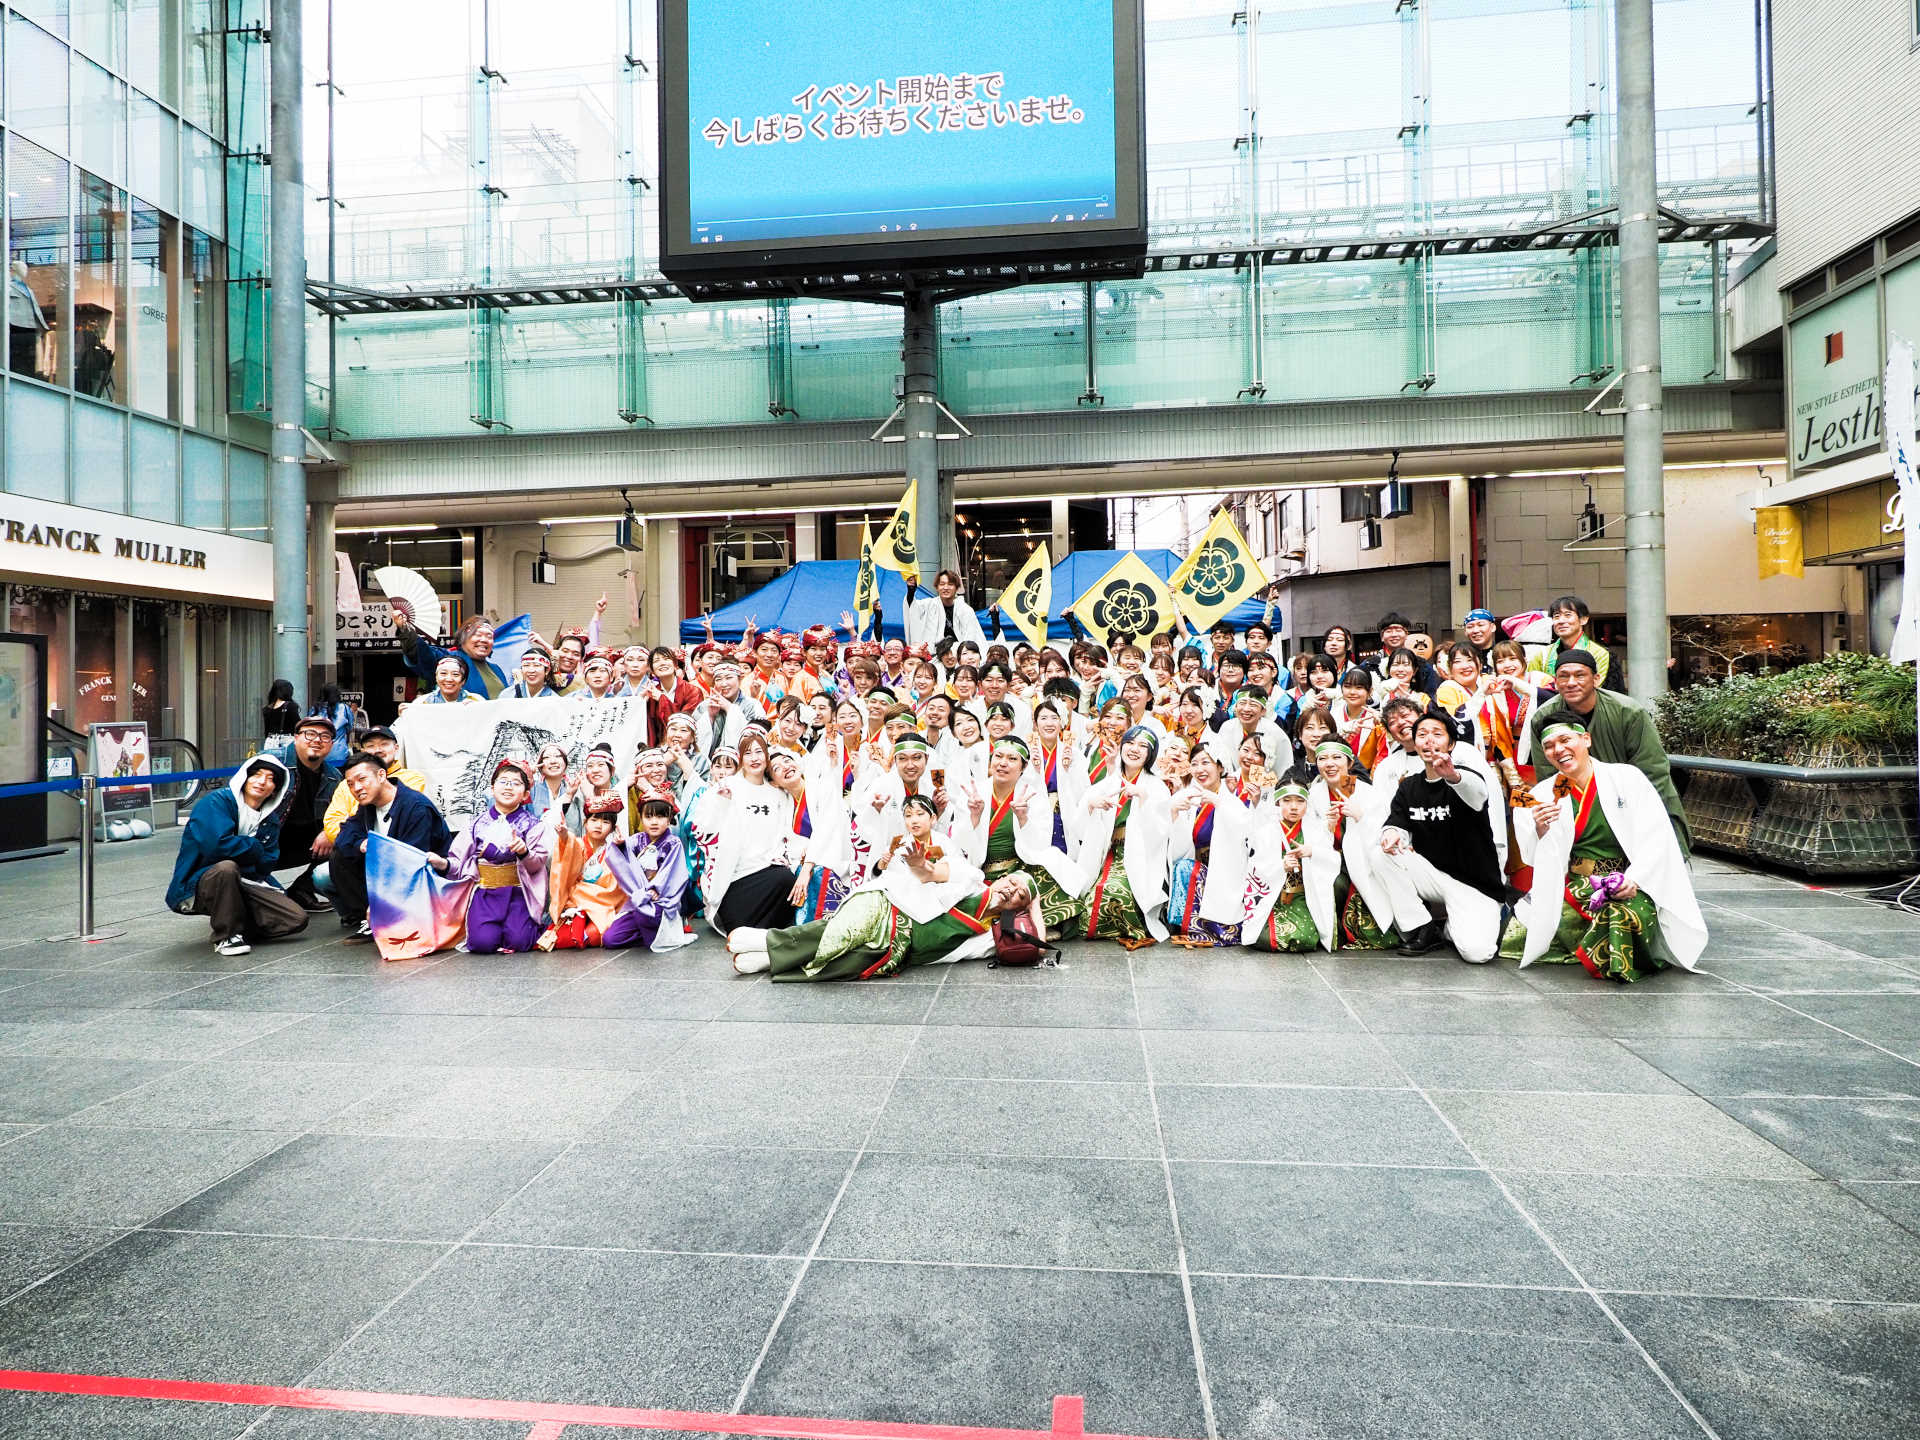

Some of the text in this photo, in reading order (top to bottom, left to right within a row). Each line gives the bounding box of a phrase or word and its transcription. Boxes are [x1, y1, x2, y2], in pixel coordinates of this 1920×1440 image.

[792, 72, 1003, 112] イベント開始まで
[703, 95, 1084, 148] 今しばらくお待ちくださいませ。
[1796, 401, 1813, 417] NEW
[1815, 391, 1840, 410] STYLE
[0, 518, 207, 570] RANCK MULLER
[78, 675, 113, 696] FRANCK
